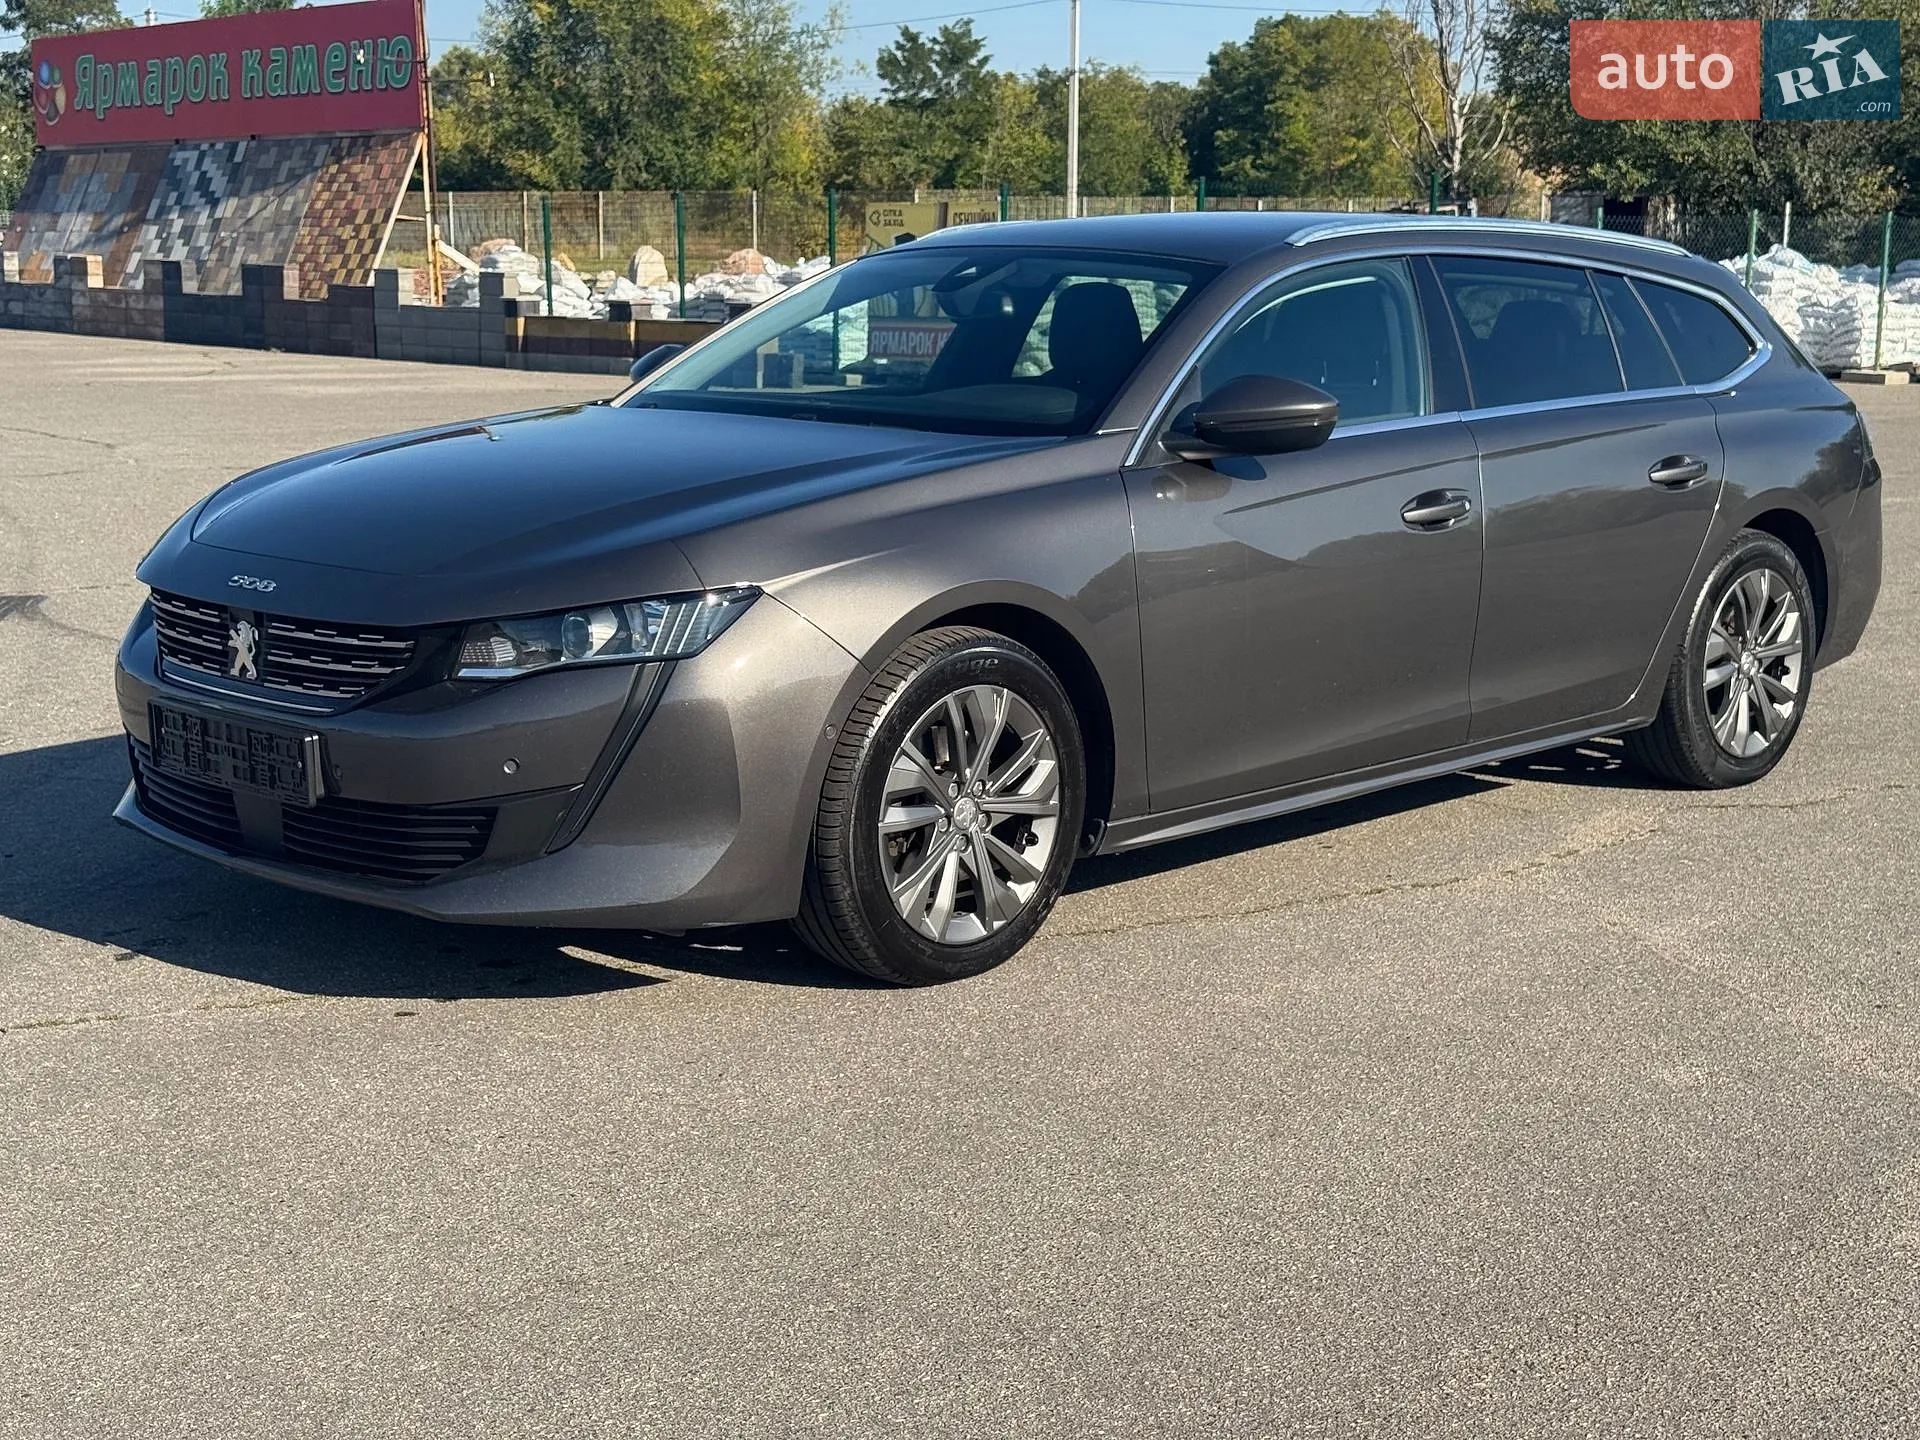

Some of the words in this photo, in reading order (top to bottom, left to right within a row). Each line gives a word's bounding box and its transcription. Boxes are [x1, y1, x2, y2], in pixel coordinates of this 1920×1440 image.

[74, 52, 230, 119] Ярмарок
[241, 35, 414, 99] каменю
[871, 331, 934, 354] ЯРМАРОК
[228, 574, 277, 593] 508
